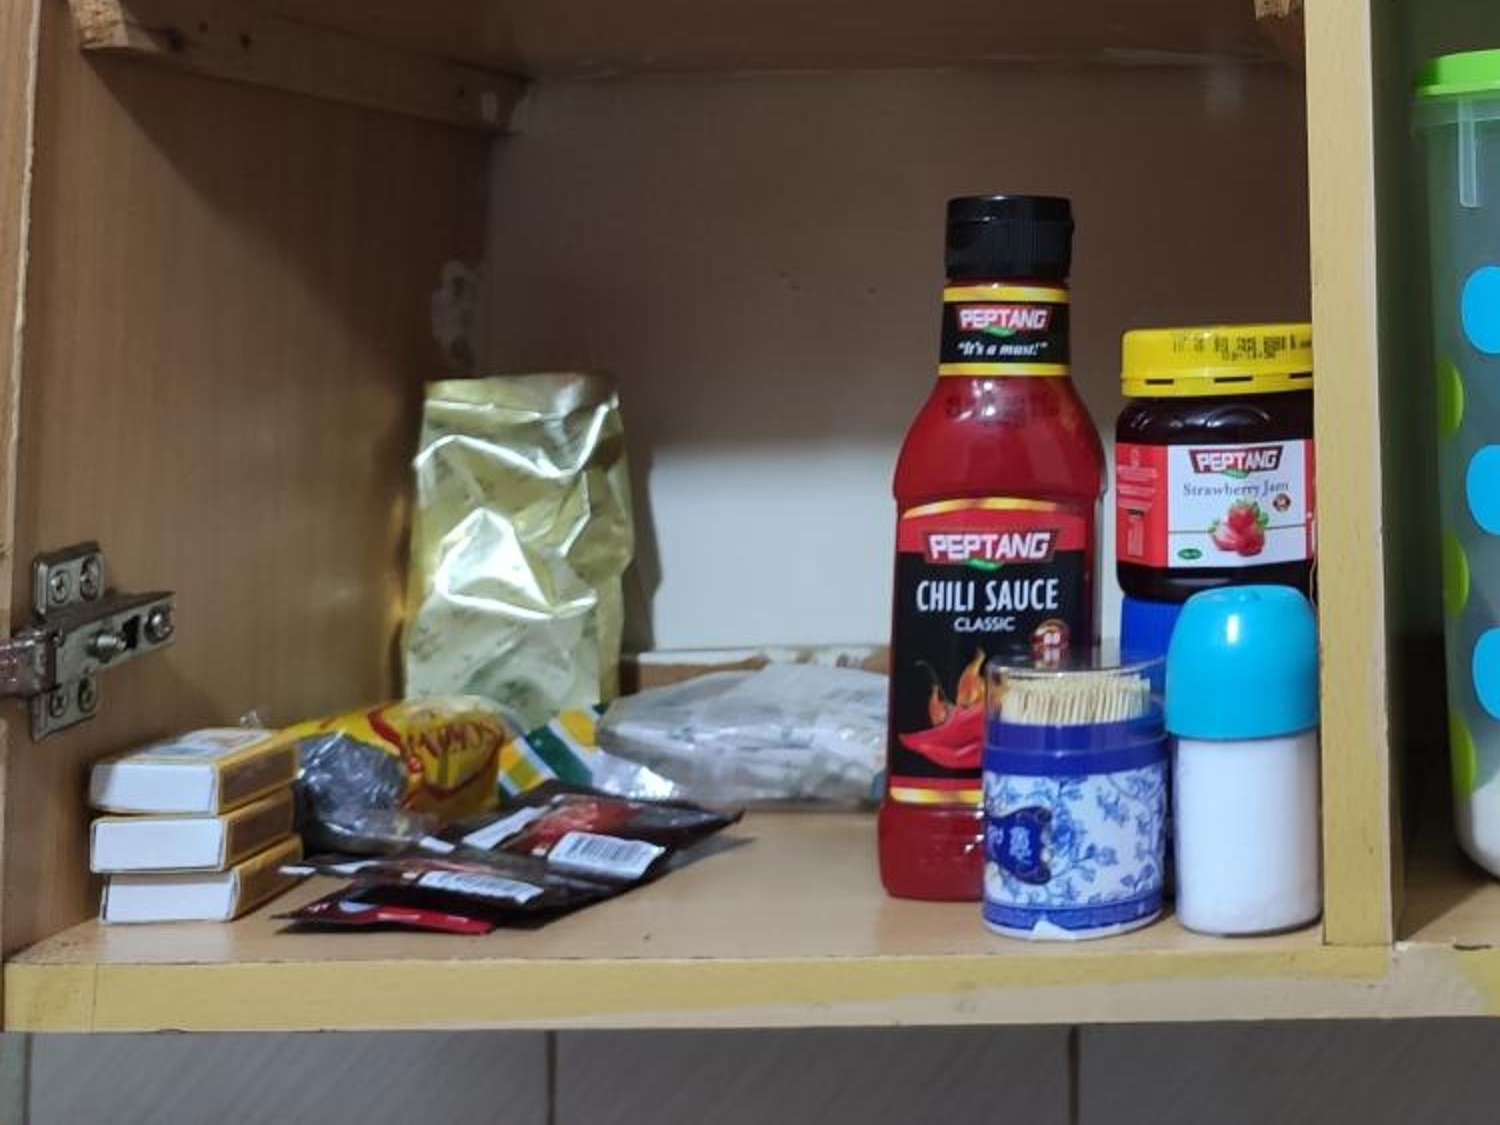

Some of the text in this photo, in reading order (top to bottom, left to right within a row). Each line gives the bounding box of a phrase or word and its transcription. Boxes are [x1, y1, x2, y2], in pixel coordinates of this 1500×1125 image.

[959, 308, 1048, 330] PEPTANG
[1195, 449, 1279, 472] PEPTANG
[1183, 479, 1290, 497] Strawberry Jam
[928, 532, 1052, 560] PEPTANG
[916, 578, 1060, 612] CHILI SAUCE
[954, 616, 1016, 632] CLASSIC
